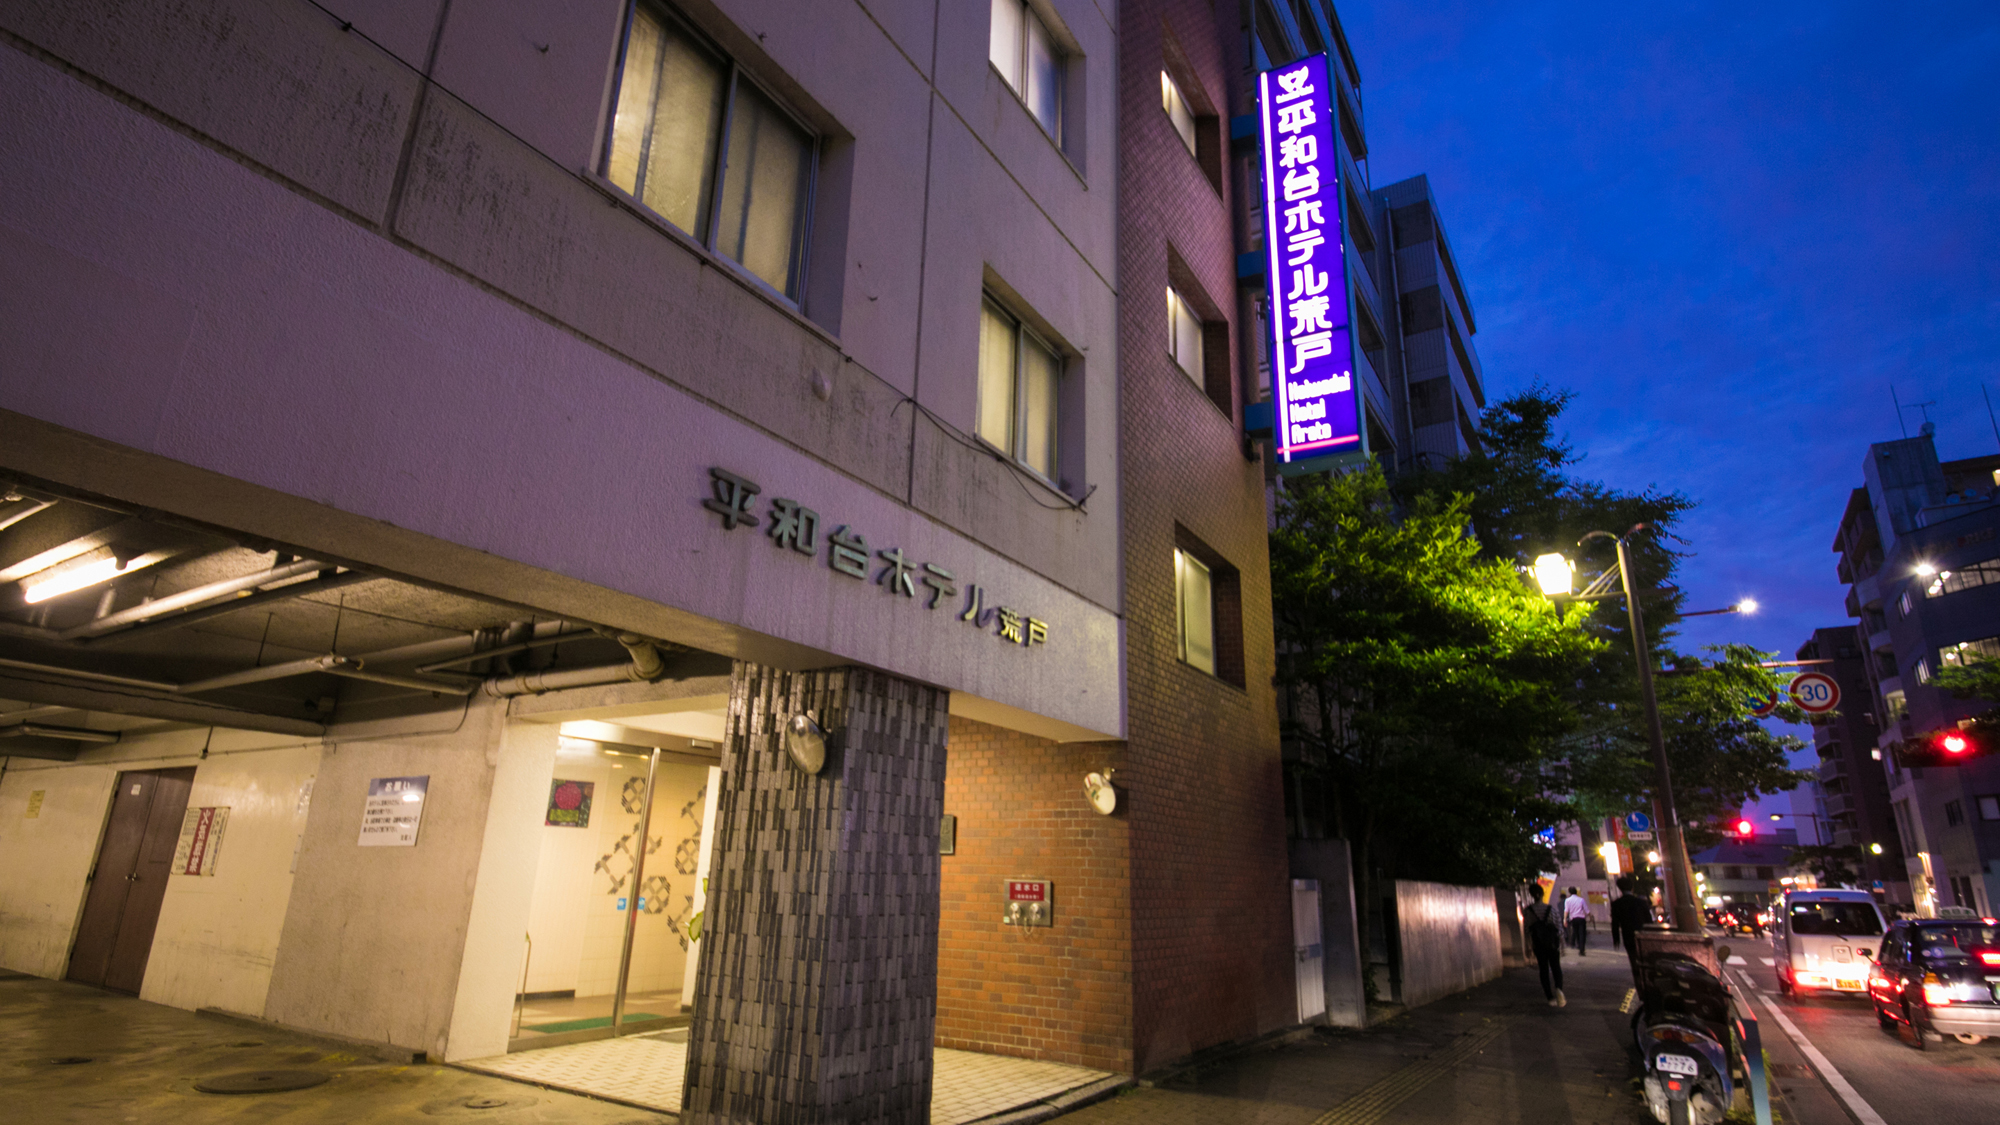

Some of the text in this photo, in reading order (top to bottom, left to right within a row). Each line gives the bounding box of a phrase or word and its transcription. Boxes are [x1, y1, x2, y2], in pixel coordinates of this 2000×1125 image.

[1278, 99, 1333, 375] 平和台ホテル荒戸
[1290, 398, 1326, 424] Hotel
[703, 467, 1049, 647] 平和台ホテル荒戸
[1801, 683, 1828, 702] 30
